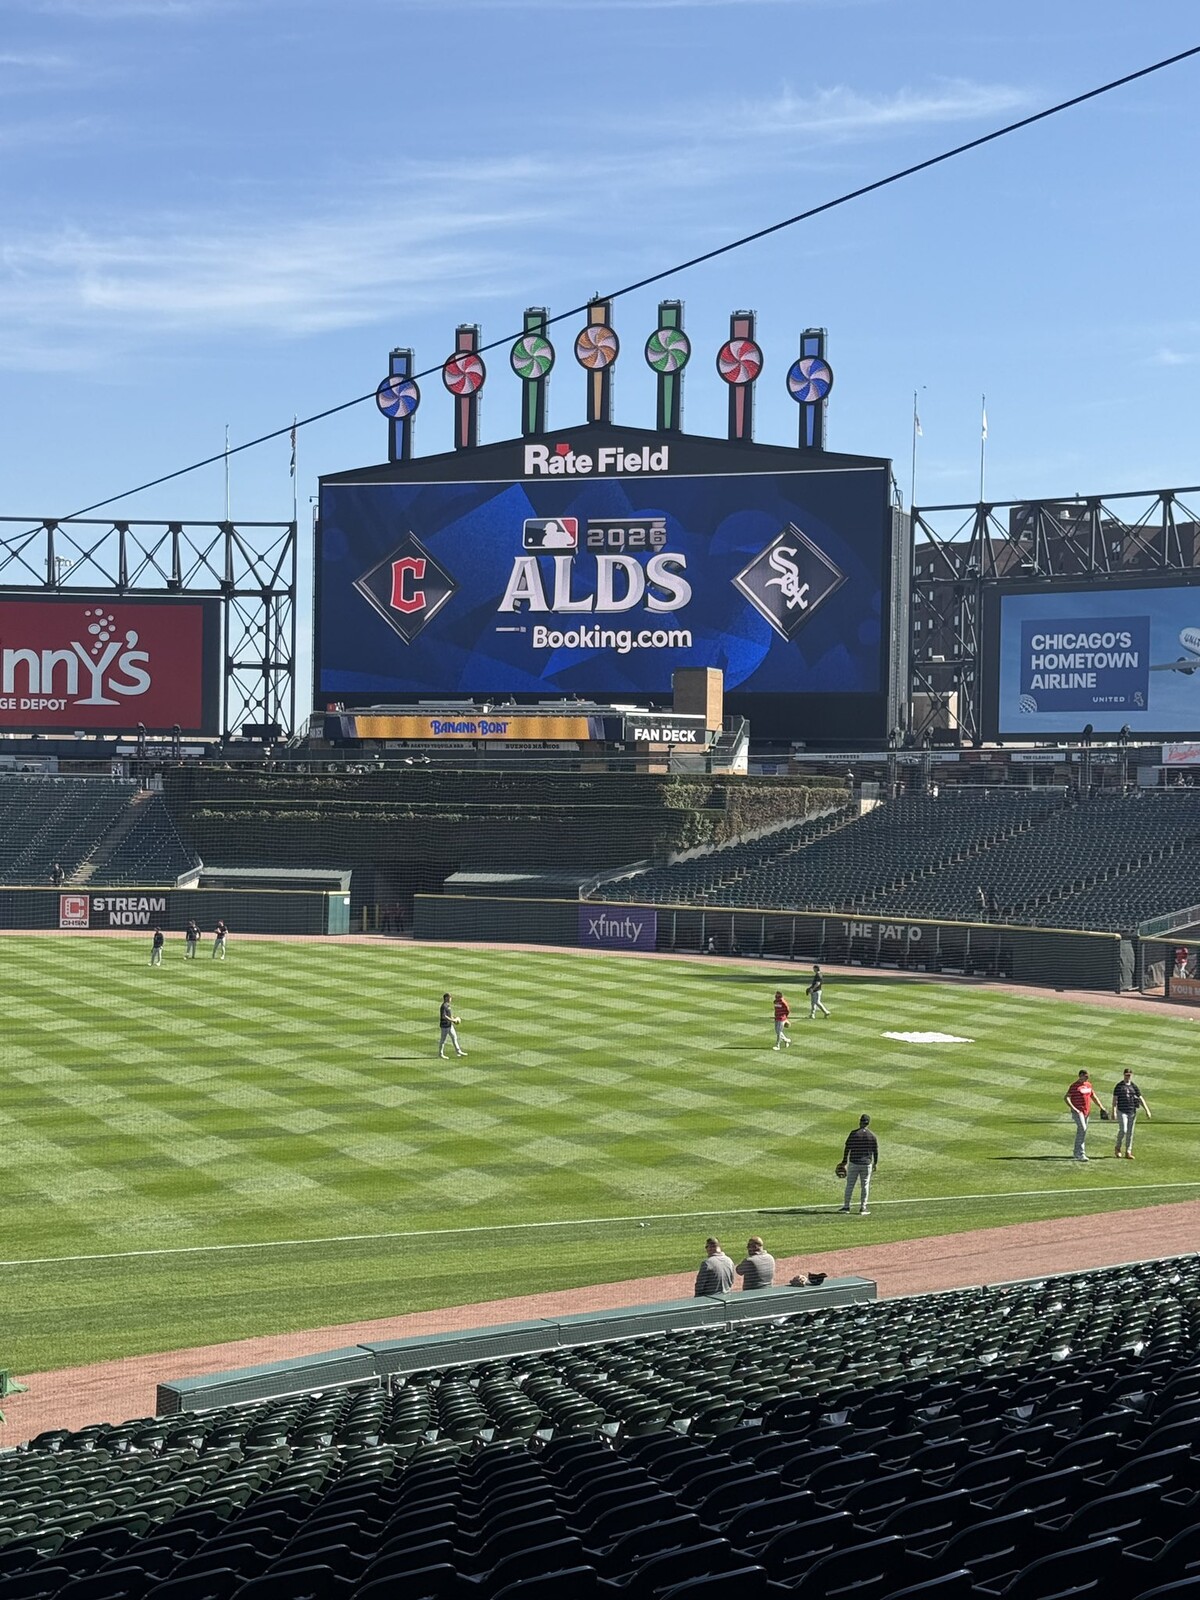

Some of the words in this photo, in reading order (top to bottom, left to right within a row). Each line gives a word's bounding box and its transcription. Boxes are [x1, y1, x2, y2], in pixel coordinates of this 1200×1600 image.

[524, 444, 593, 475] Rate
[598, 445, 669, 473] Field
[587, 527, 666, 547] 2026
[390, 556, 427, 614] C
[497, 552, 692, 613] ALDS
[532, 625, 693, 654] Booking.com
[1031, 631, 1132, 650] CHICAGO'S
[1031, 652, 1139, 670] HOMETOWN
[1030, 673, 1097, 690] AIRLINE
[20, 698, 67, 711] DEPOT
[430, 719, 477, 735] BANANA
[634, 727, 661, 741] FAN
[663, 728, 696, 742] DECK
[93, 897, 166, 911] STREAM
[109, 912, 150, 925] NOW
[588, 913, 643, 942] xfinity
[879, 924, 922, 941] PATO
